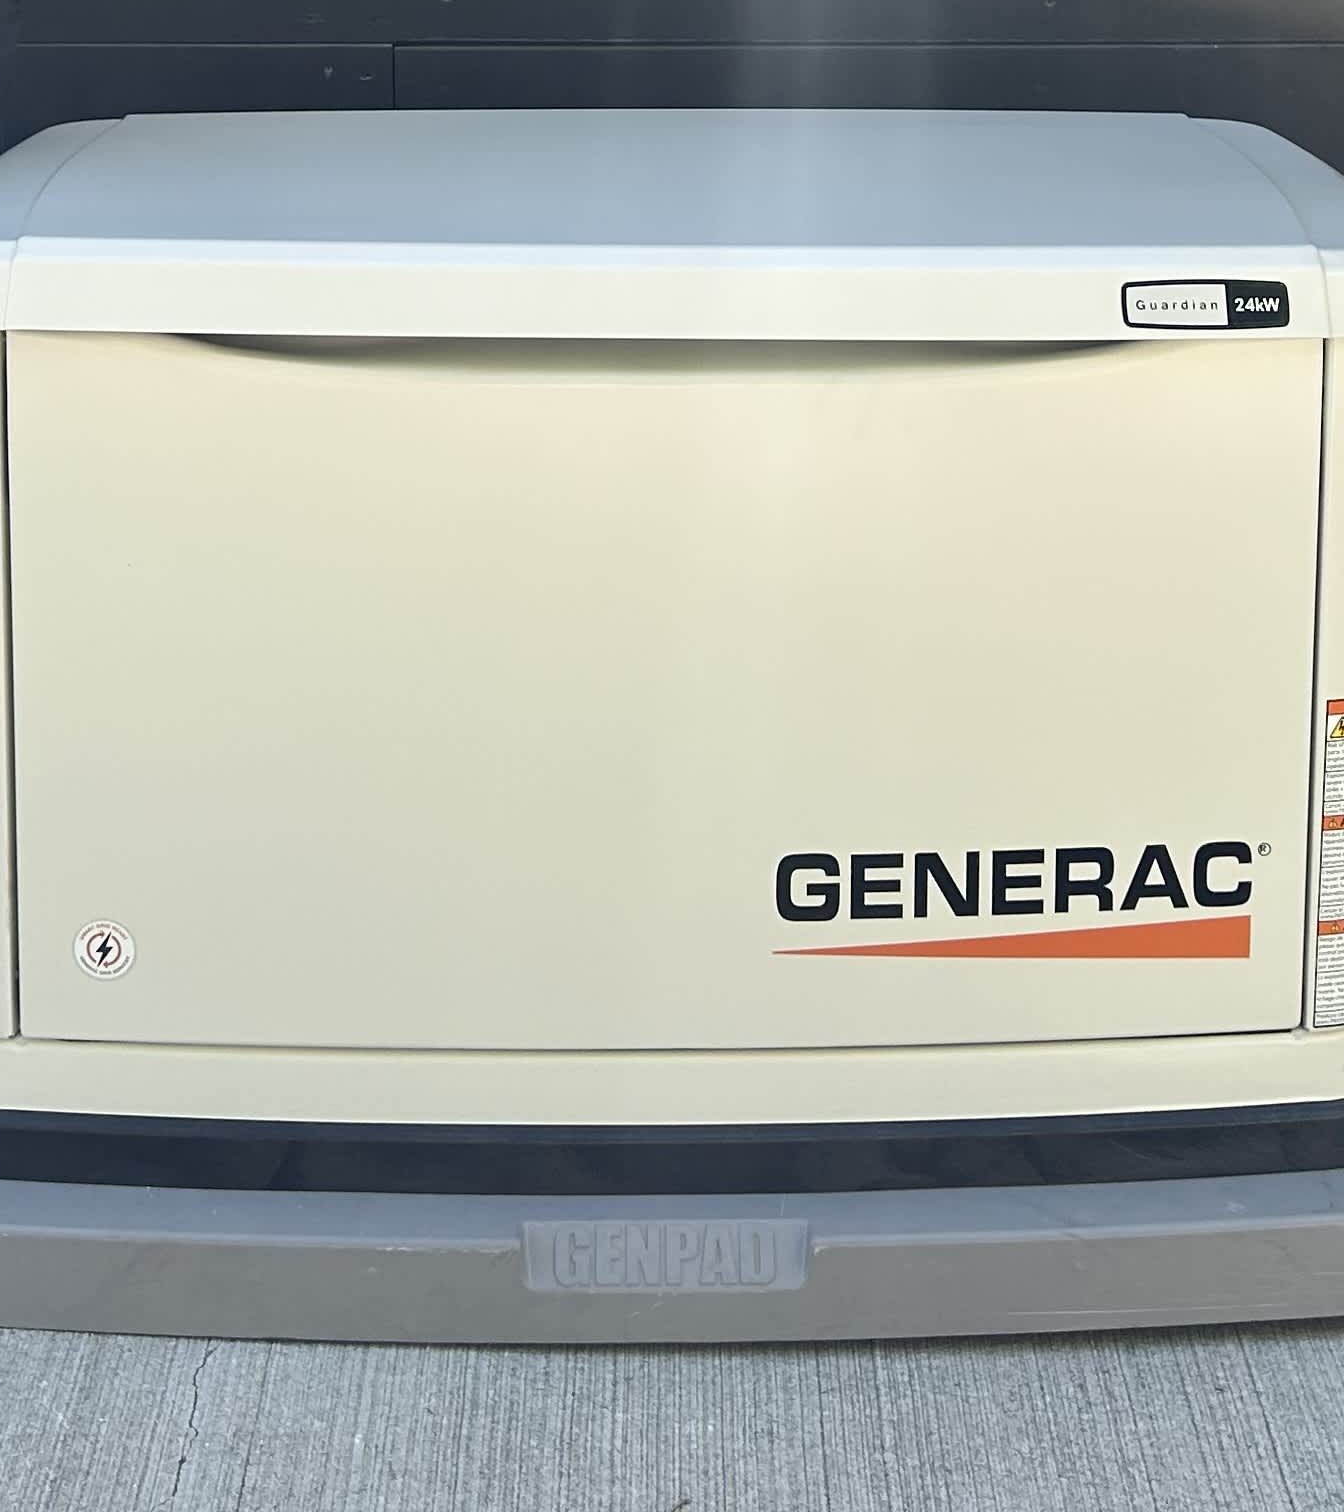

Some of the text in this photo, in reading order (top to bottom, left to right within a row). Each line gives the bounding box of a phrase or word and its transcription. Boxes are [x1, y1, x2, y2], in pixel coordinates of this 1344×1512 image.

[1135, 297, 1280, 313] Guardian 24kW
[774, 840, 1253, 922] GENERAC
[553, 1223, 777, 1288] GENPAD
